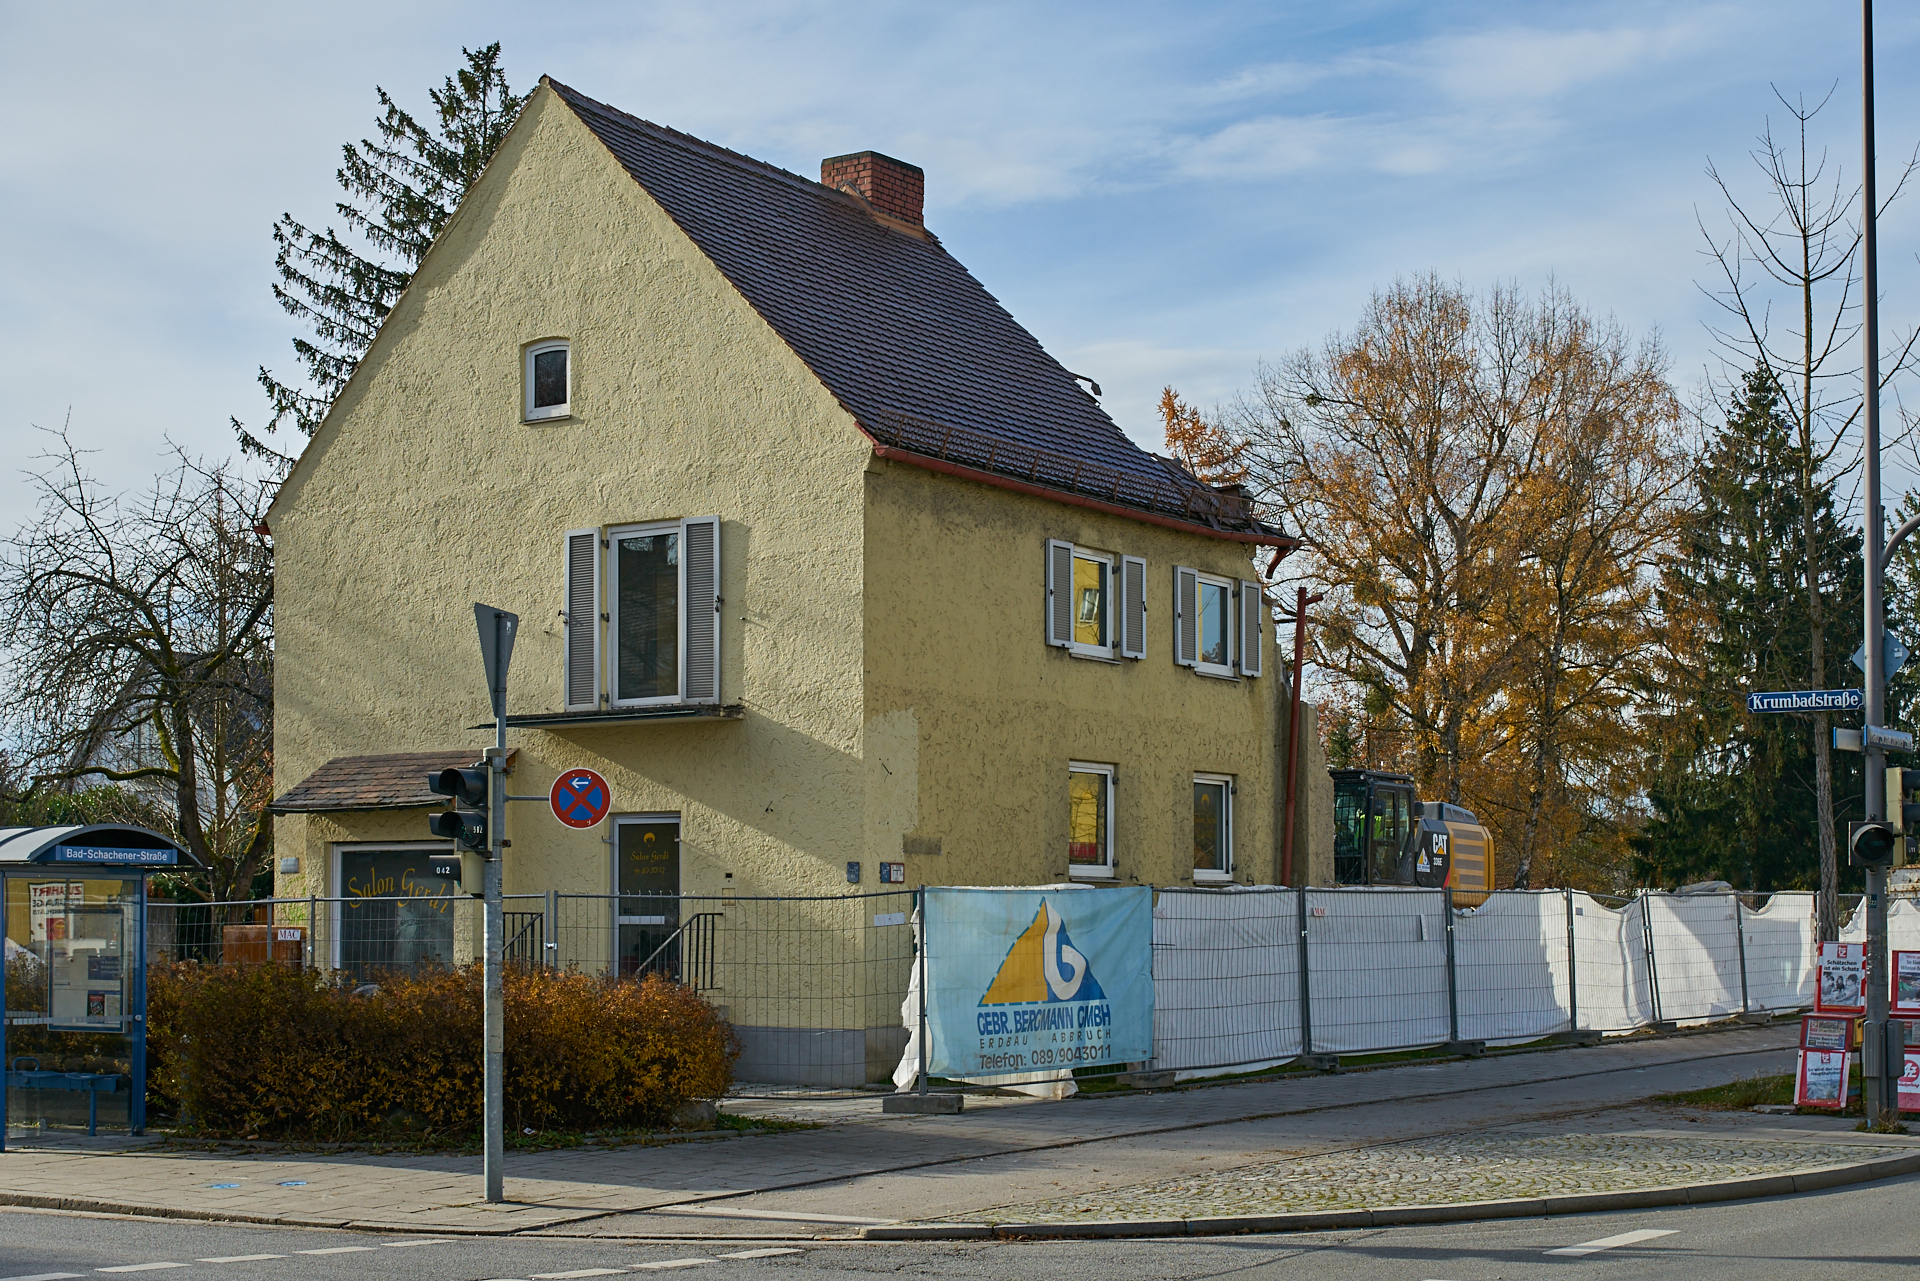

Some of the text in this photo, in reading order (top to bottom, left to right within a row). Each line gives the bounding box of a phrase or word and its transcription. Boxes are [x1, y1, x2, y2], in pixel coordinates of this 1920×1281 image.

[1753, 691, 1858, 710] Krumbadstraße
[1432, 833, 1448, 855] CAT
[66, 848, 168, 861] Bad-Schachener-Straße
[630, 850, 669, 863] Salon Gerdi
[436, 866, 451, 874] 042
[348, 866, 395, 909] Salon
[397, 868, 452, 914] Gerdi
[279, 930, 300, 939] MAC
[977, 1003, 1111, 1036] GEBR. BERGMANN GMBH
[979, 1028, 1112, 1049] ERDBAU ABBRUCH
[979, 1044, 1112, 1070] Telefon: 089/9043011
